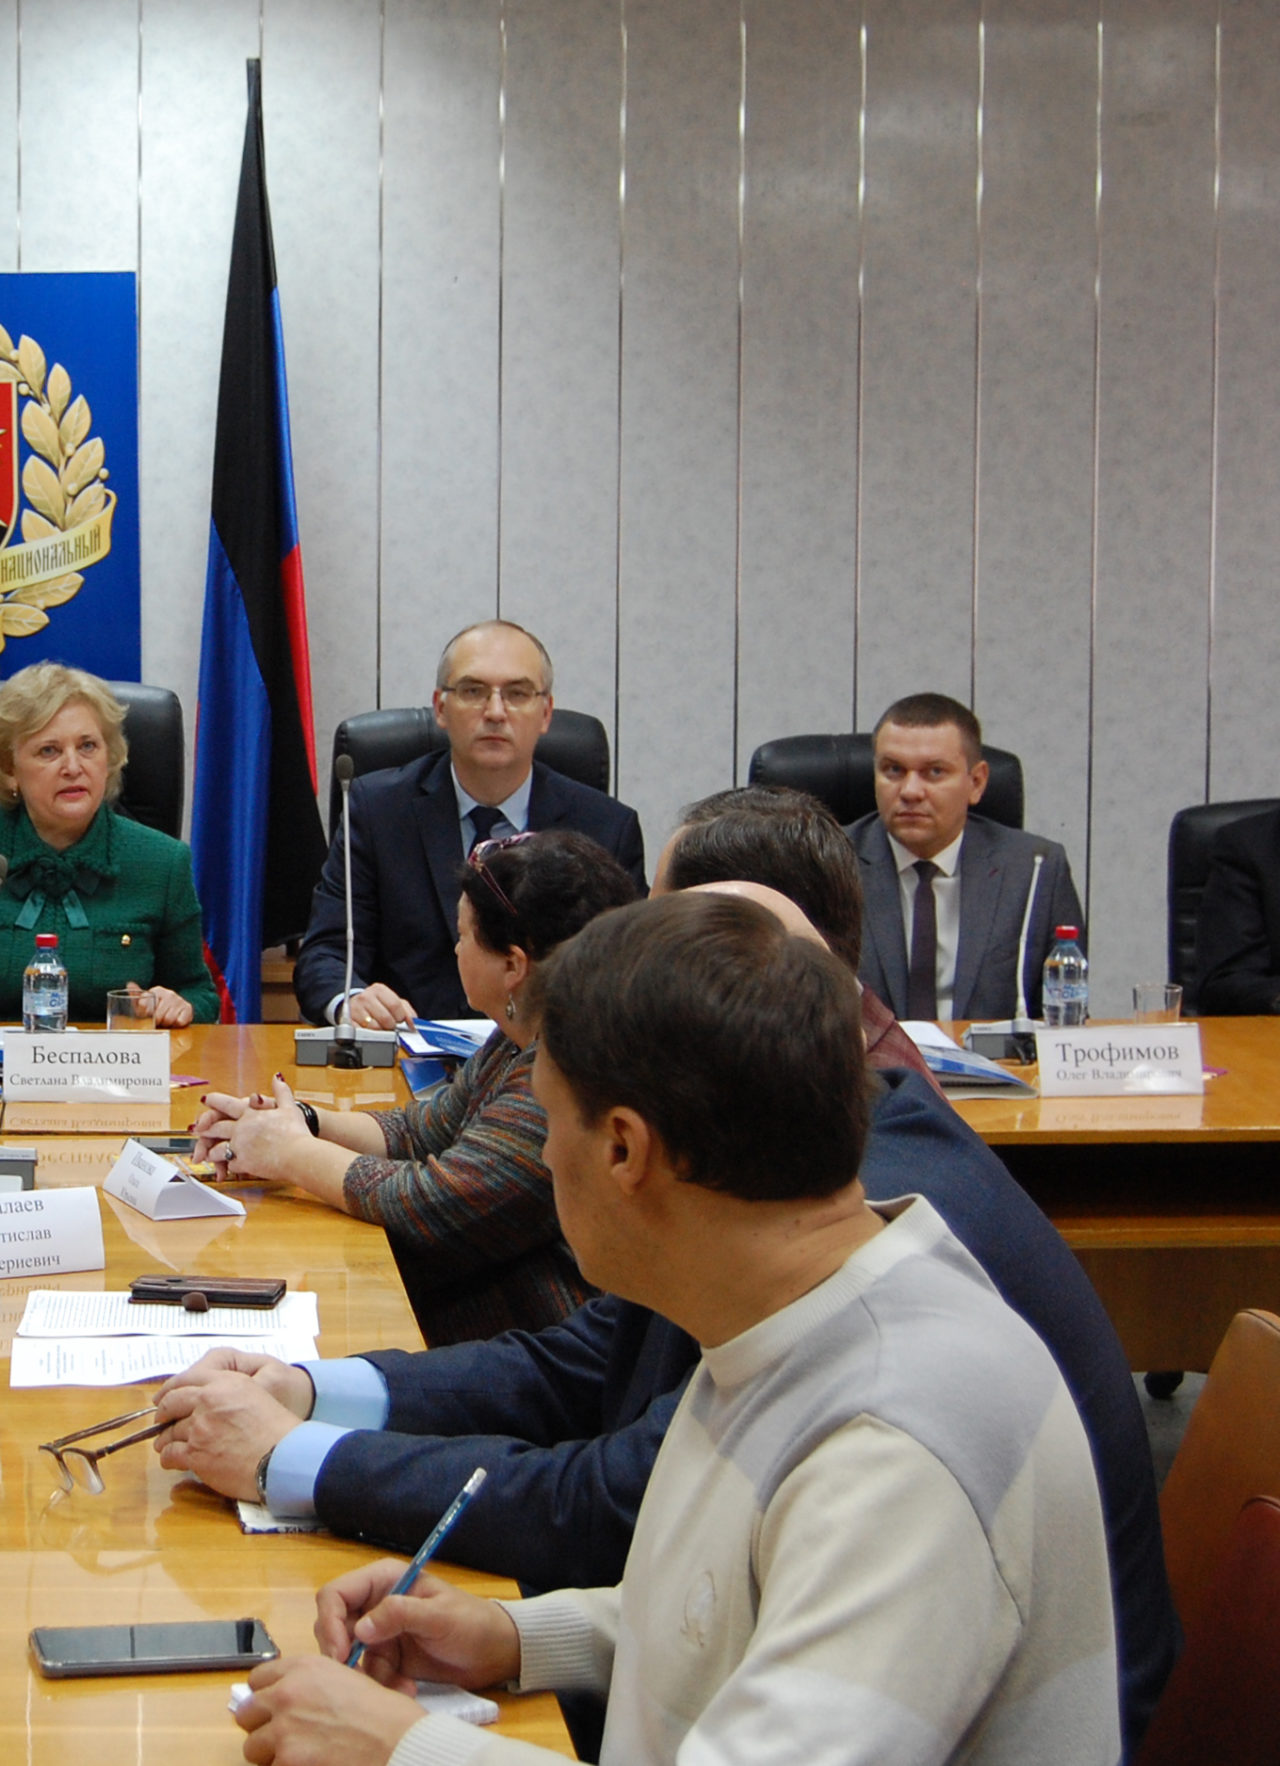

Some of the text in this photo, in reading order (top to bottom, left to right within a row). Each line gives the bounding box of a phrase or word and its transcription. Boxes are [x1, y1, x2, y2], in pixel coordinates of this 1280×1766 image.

[31, 1045, 142, 1065] Беспалова
[1055, 1042, 1180, 1068] Трофимов
[9, 1073, 68, 1087] Светлана
